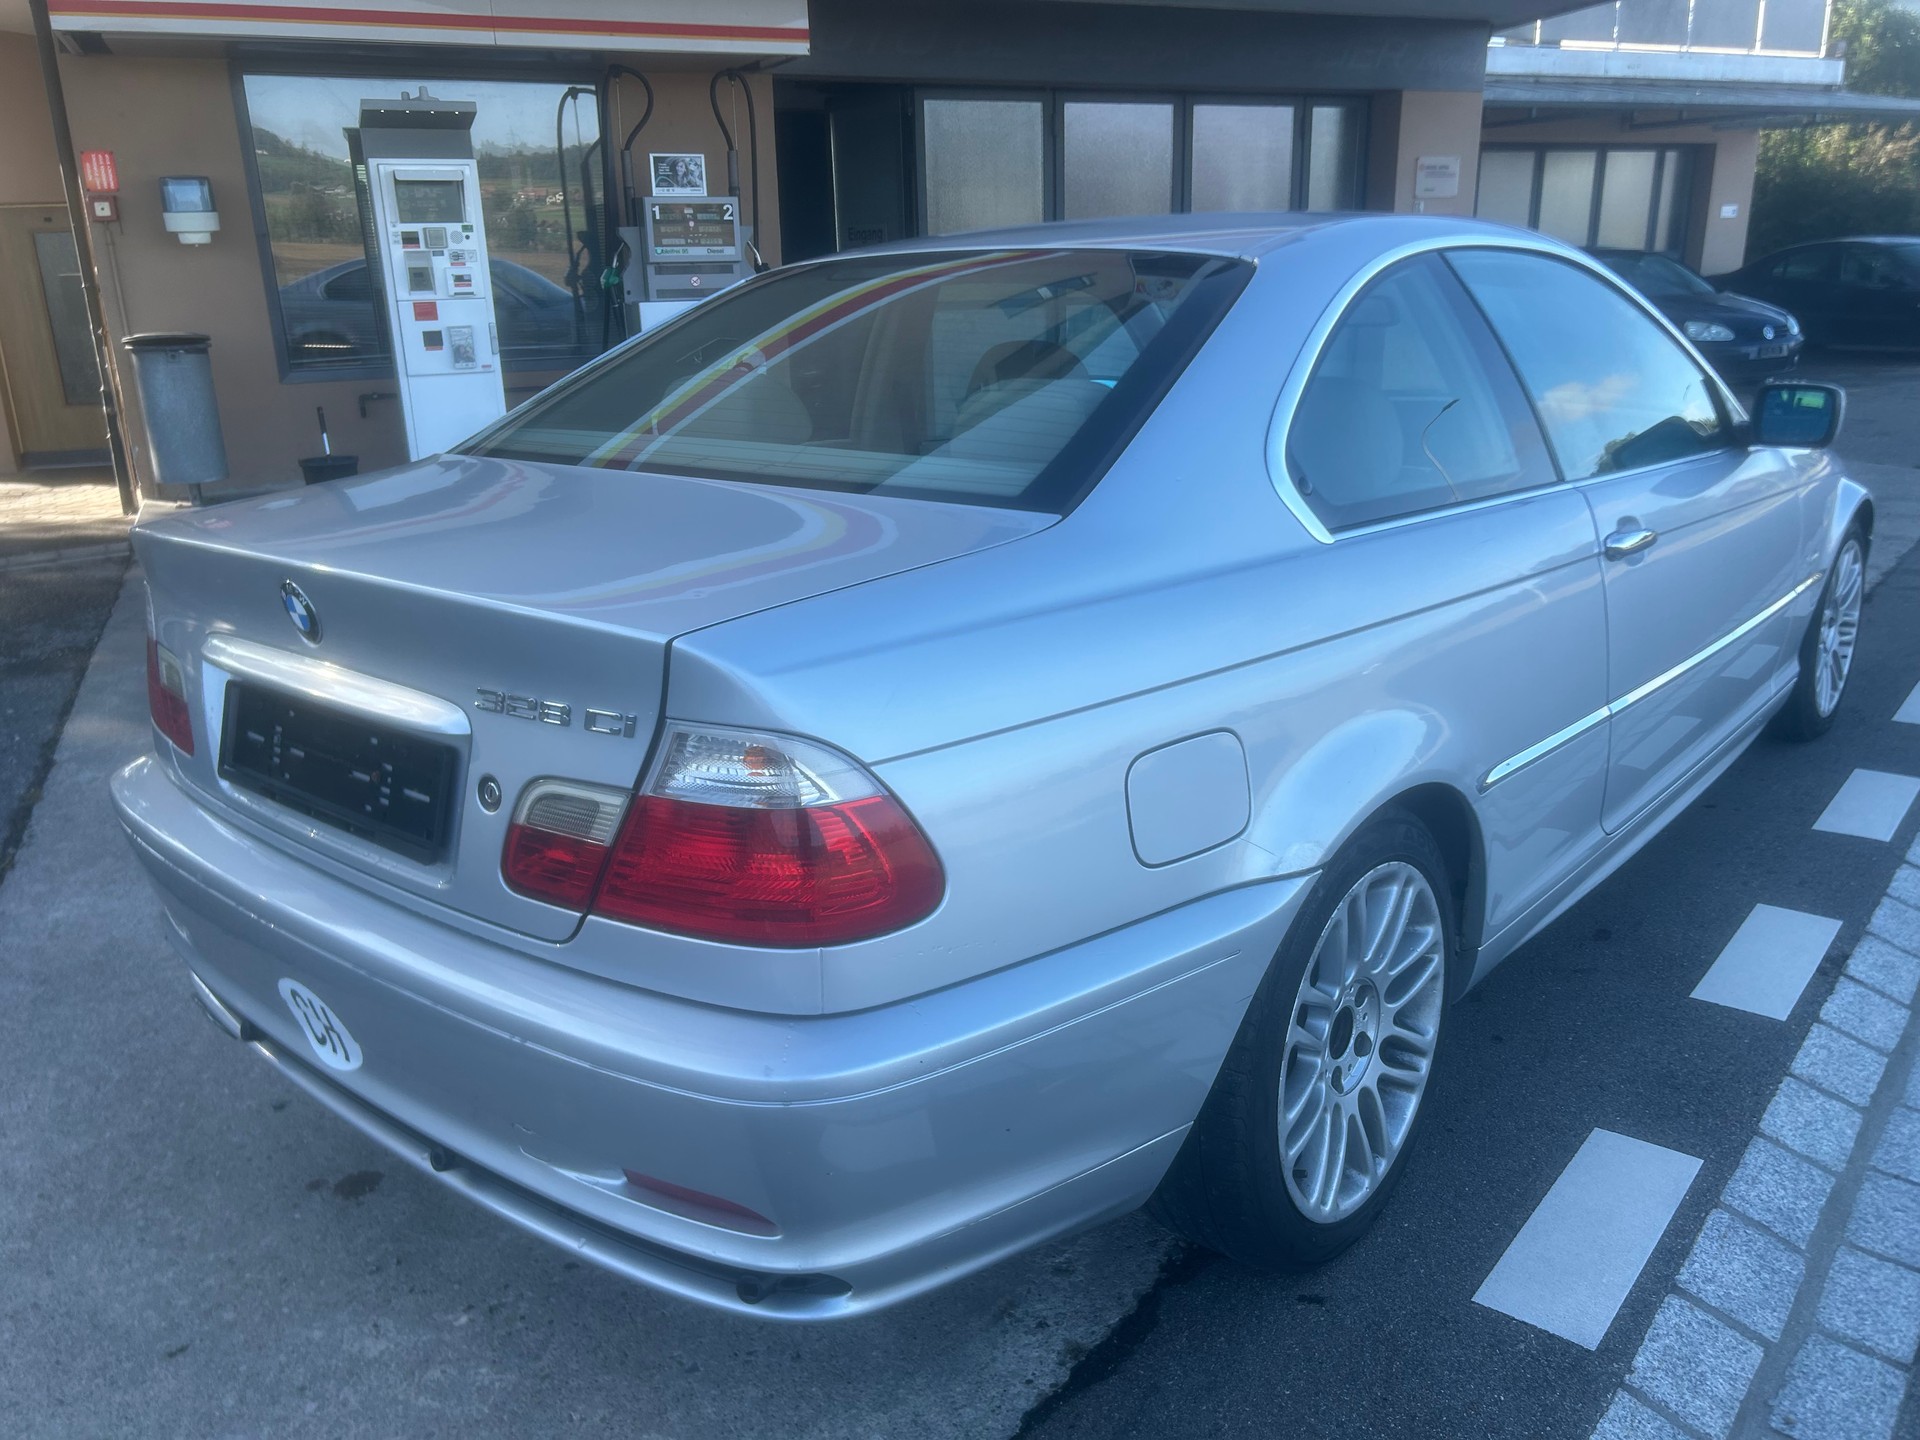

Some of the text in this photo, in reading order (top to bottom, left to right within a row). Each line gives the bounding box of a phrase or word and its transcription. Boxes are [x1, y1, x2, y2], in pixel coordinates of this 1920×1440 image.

[652, 205, 660, 220] 1
[723, 204, 734, 220] 2
[848, 226, 883, 244] Eingang
[474, 686, 638, 739] 328 Ci
[290, 988, 351, 1063] CH
